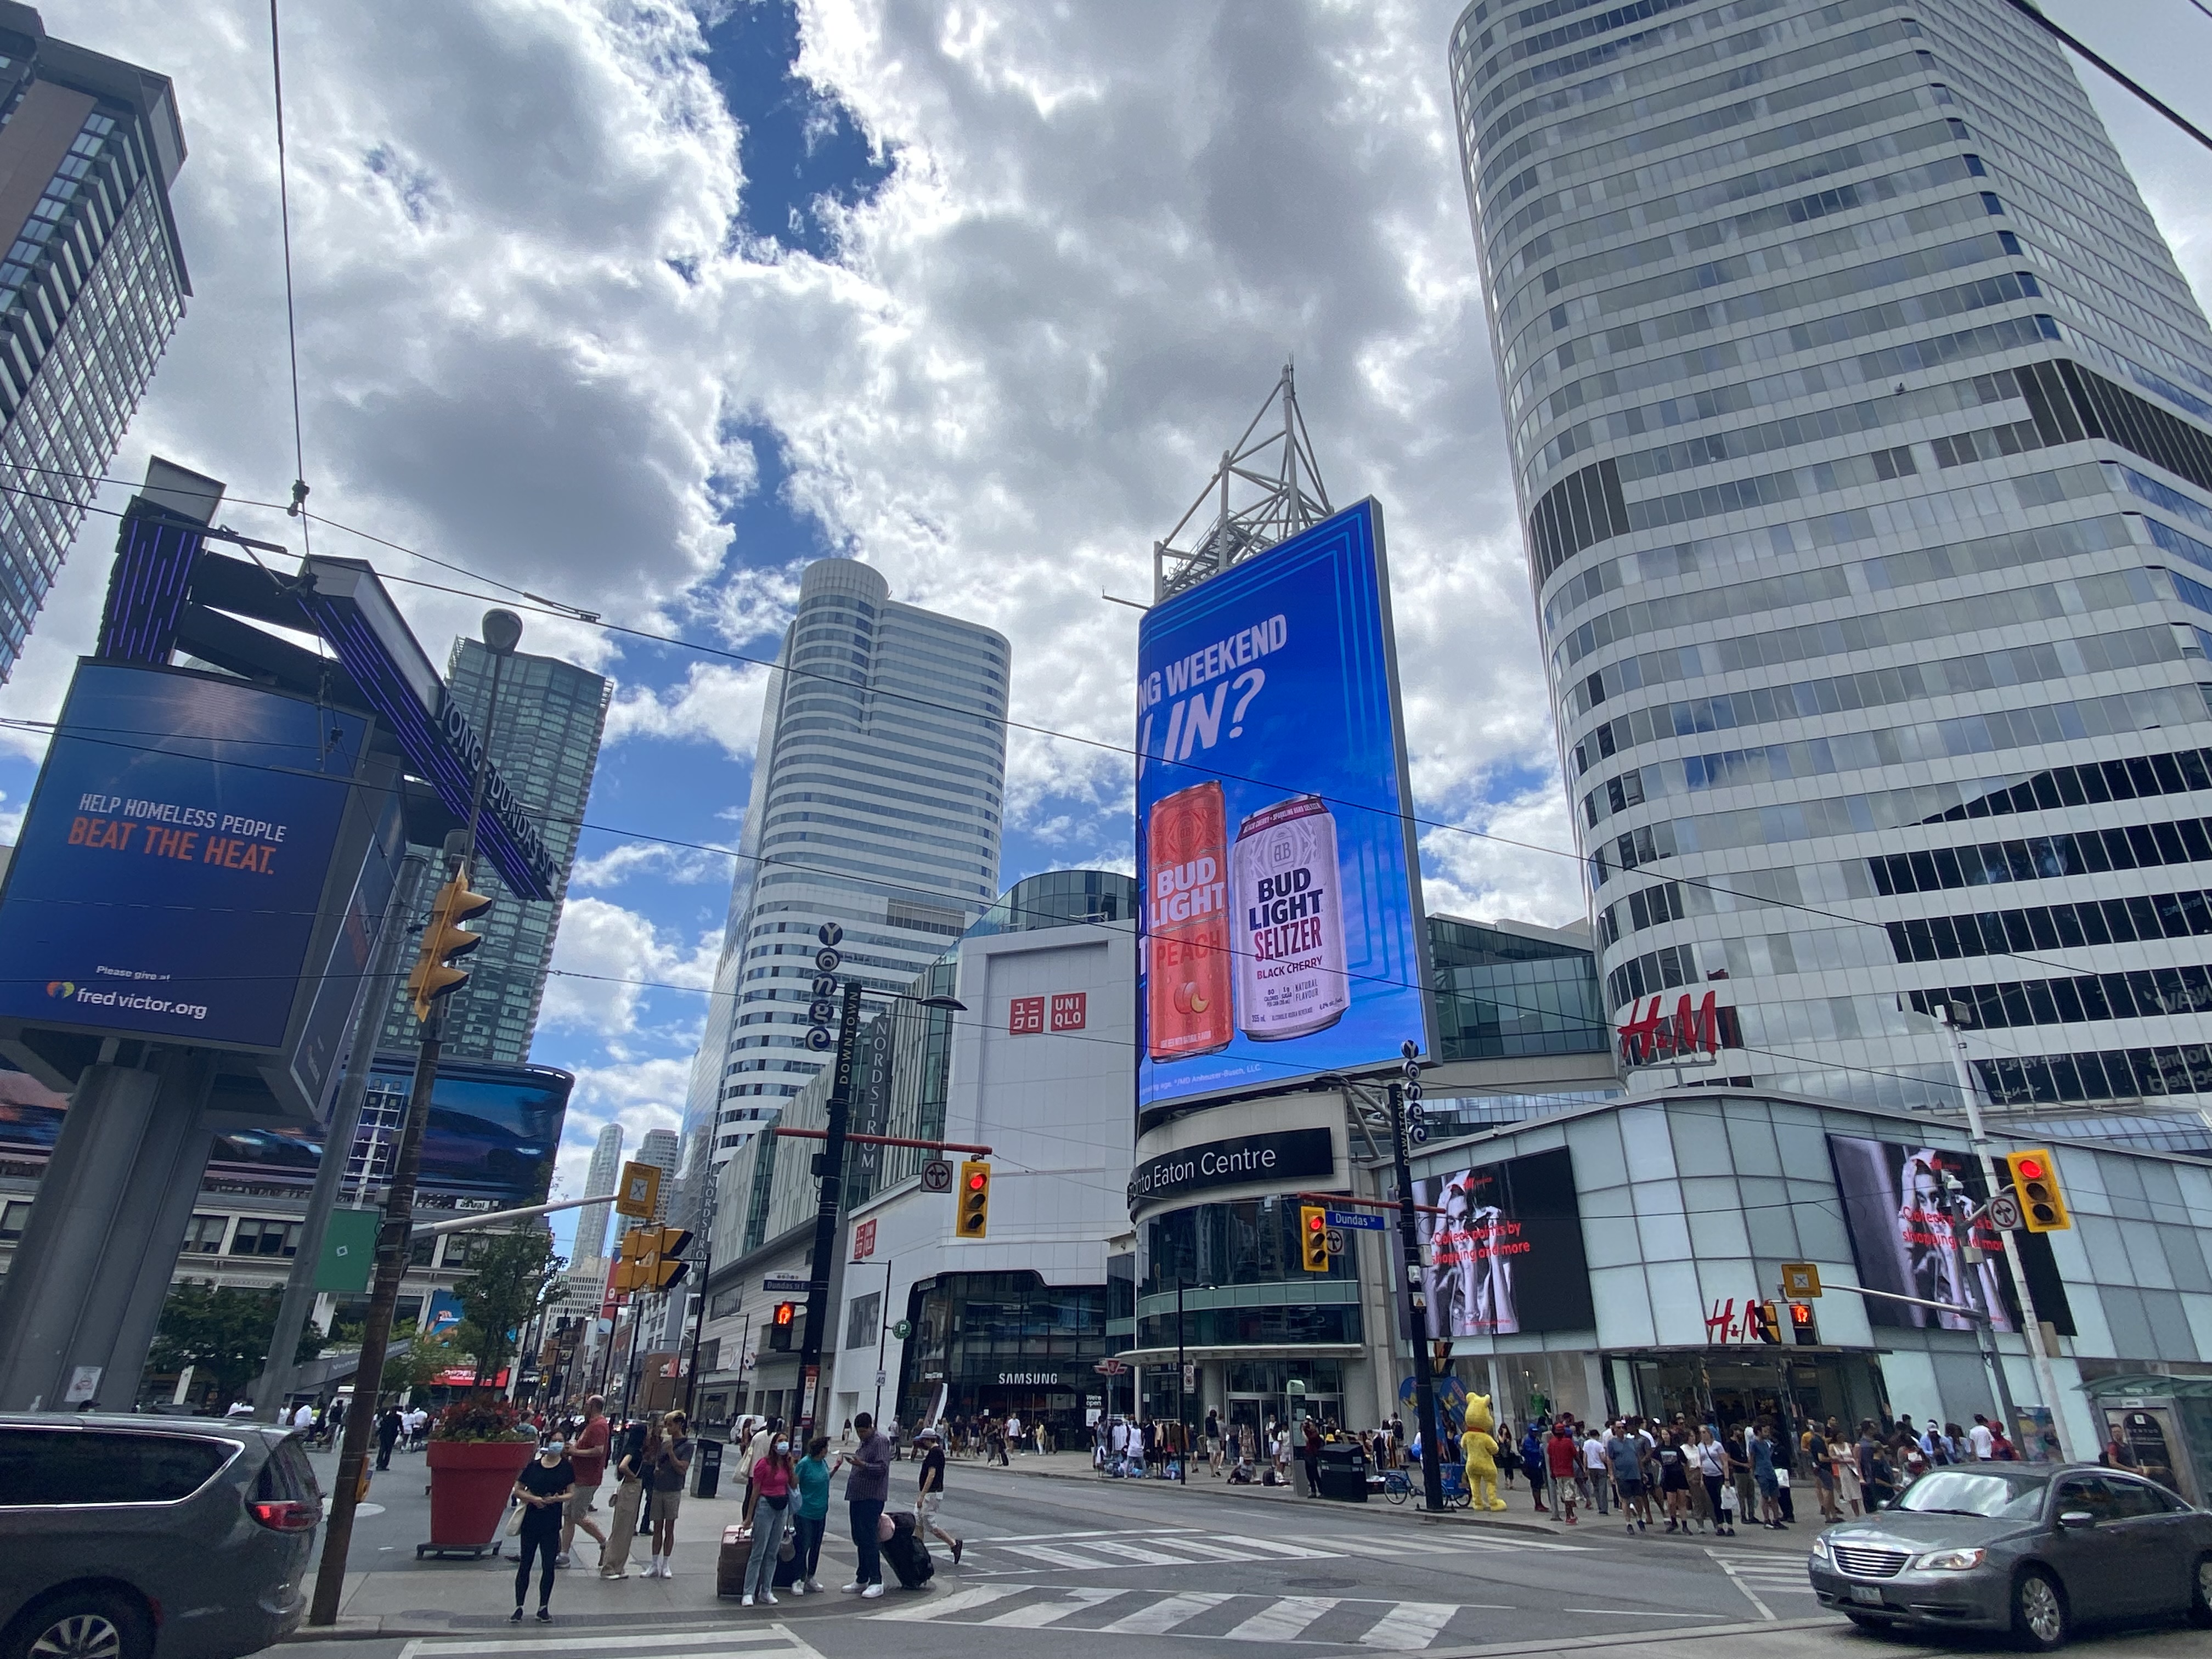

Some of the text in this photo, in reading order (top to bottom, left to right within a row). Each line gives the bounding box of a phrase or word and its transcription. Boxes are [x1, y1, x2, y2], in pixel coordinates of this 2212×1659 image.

[1166, 614, 1287, 697] WEEKEND
[1162, 668, 1266, 766] IN?
[79, 793, 287, 843] HELP HOMELESS PEOPLE
[67, 816, 276, 875] BEAT THE HEAT.
[1158, 857, 1216, 899] BUD
[1257, 868, 1311, 904] BUD
[1150, 882, 1225, 929] LIGHT
[1249, 889, 1323, 931] LIGHT
[1156, 930, 1220, 970] PEACH
[1254, 916, 1323, 962] SELTZER
[96, 966, 132, 978] Please
[134, 970, 157, 980] give
[806, 922, 841, 1051] Yonge
[1257, 955, 1323, 980] BLACK CHERRY
[1295, 979, 1318, 992] NATURAL
[1055, 997, 1079, 1011] UNI
[1295, 988, 1319, 1002] FLAVOUR
[839, 991, 858, 1084] DOWNTOWN
[1054, 1012, 1081, 1028] QLO
[1617, 990, 1716, 1059] H&M
[861, 1022, 888, 1168] NORDSTROM
[1401, 1040, 1427, 1144] Yonge
[1396, 1091, 1410, 1166] DOWNTOWN
[1154, 1161, 1194, 1188] Eaton
[1200, 1148, 1276, 1176] Centre
[693, 1179, 714, 1269] NORDSTROM
[1335, 1213, 1368, 1227] Dundas
[1434, 1220, 1522, 1246] Collect points by
[1903, 1228, 1957, 1250] shopping
[1431, 1241, 1531, 1266] shopping and more
[768, 1281, 794, 1290] Dundas
[900, 1324, 907, 1334] P
[876, 1376, 885, 1385] 40
[998, 1373, 1058, 1385] SAMSUNG
